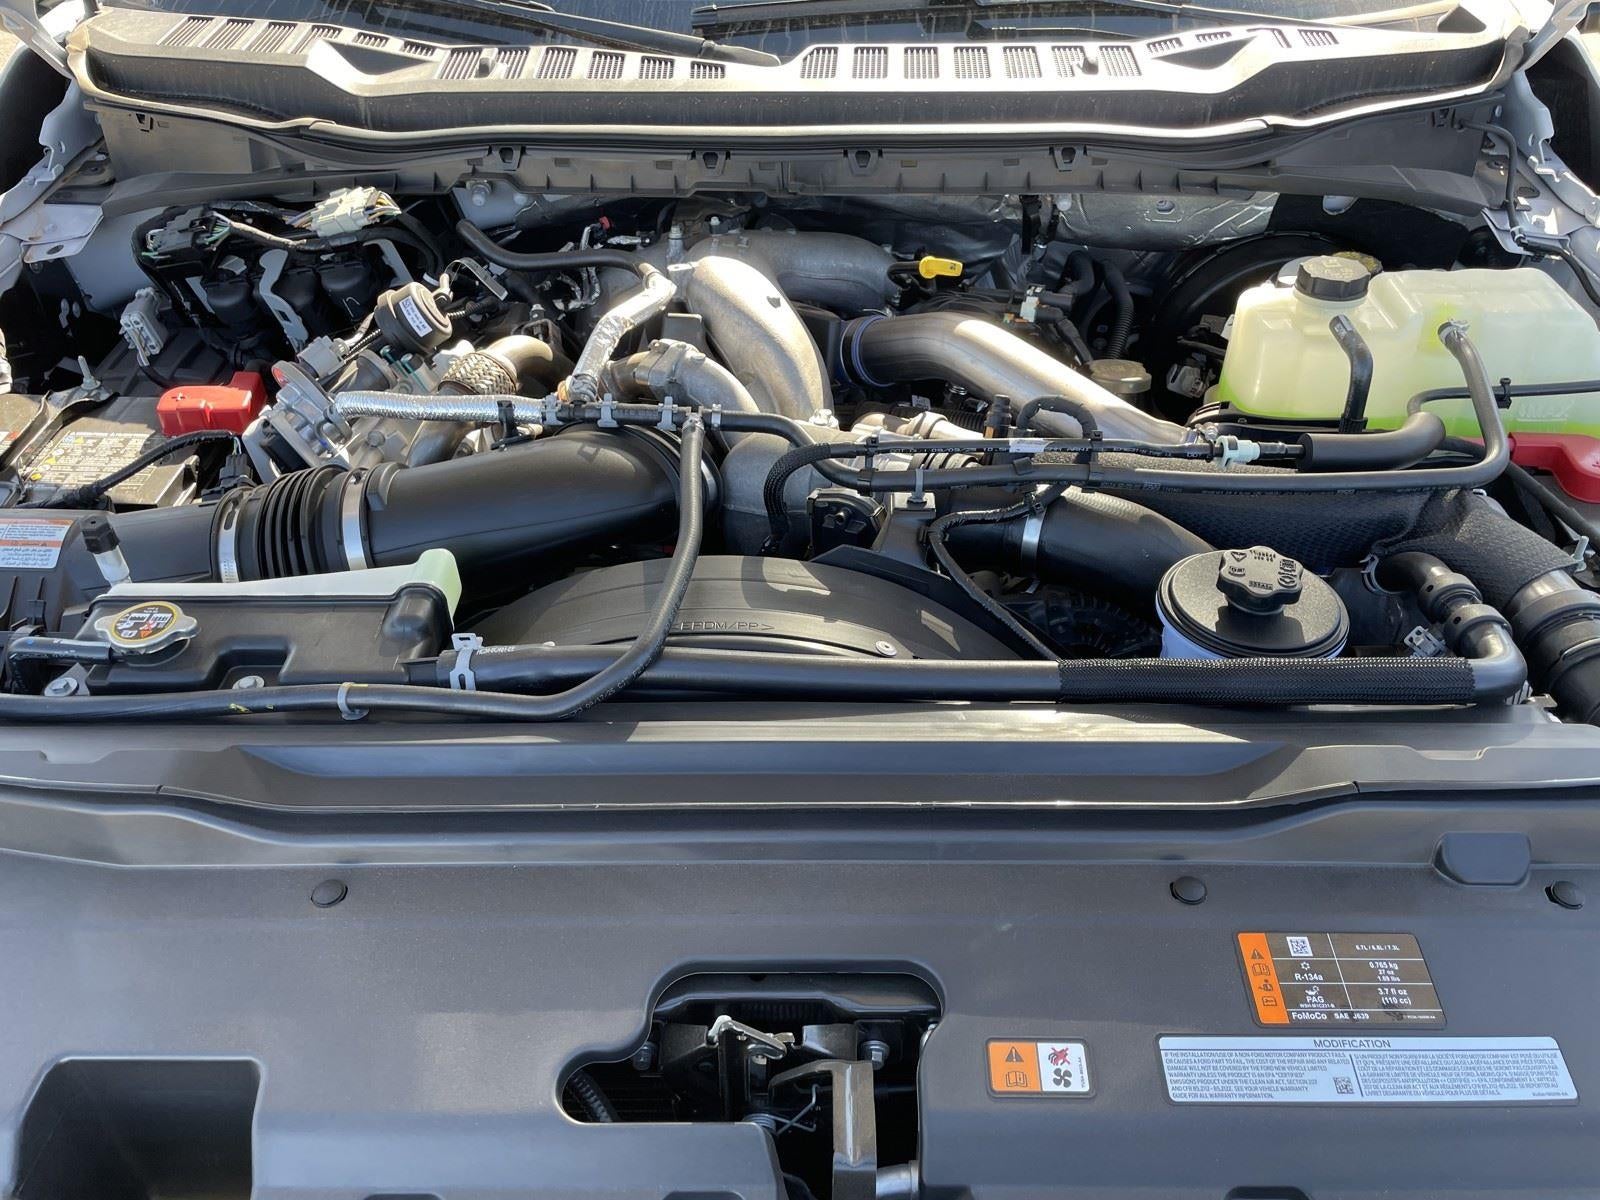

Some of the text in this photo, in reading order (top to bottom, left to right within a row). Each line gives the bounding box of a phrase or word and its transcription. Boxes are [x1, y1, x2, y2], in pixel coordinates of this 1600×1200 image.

[1369, 961, 1399, 970] 0.765 kg
[1294, 973, 1324, 982] R-134a
[1377, 987, 1389, 995] 3.7
[1381, 996, 1412, 1005] (110 cc)
[1291, 1011, 1370, 1020] FoMoCo SAE J639
[1313, 1039, 1392, 1048] MODIFICATION
